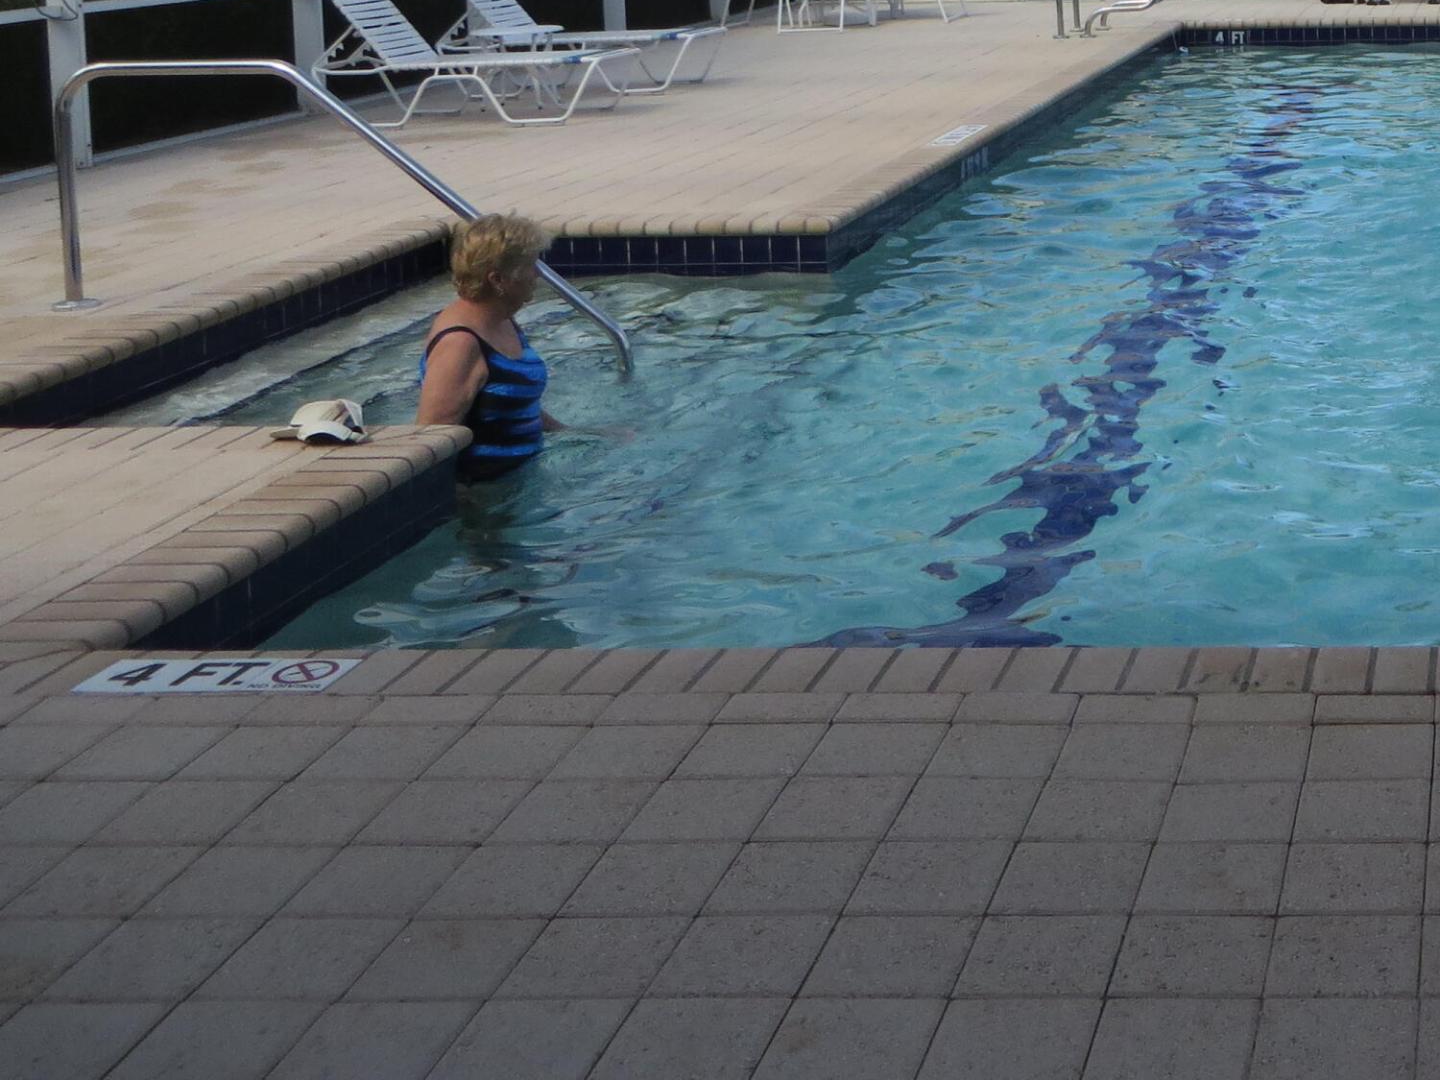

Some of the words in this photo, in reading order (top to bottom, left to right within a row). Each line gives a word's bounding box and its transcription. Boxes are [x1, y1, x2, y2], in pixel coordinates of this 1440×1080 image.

[1215, 31, 1224, 44] 4
[1231, 31, 1245, 44] FT
[107, 662, 168, 687] 4
[169, 661, 271, 686] FT.
